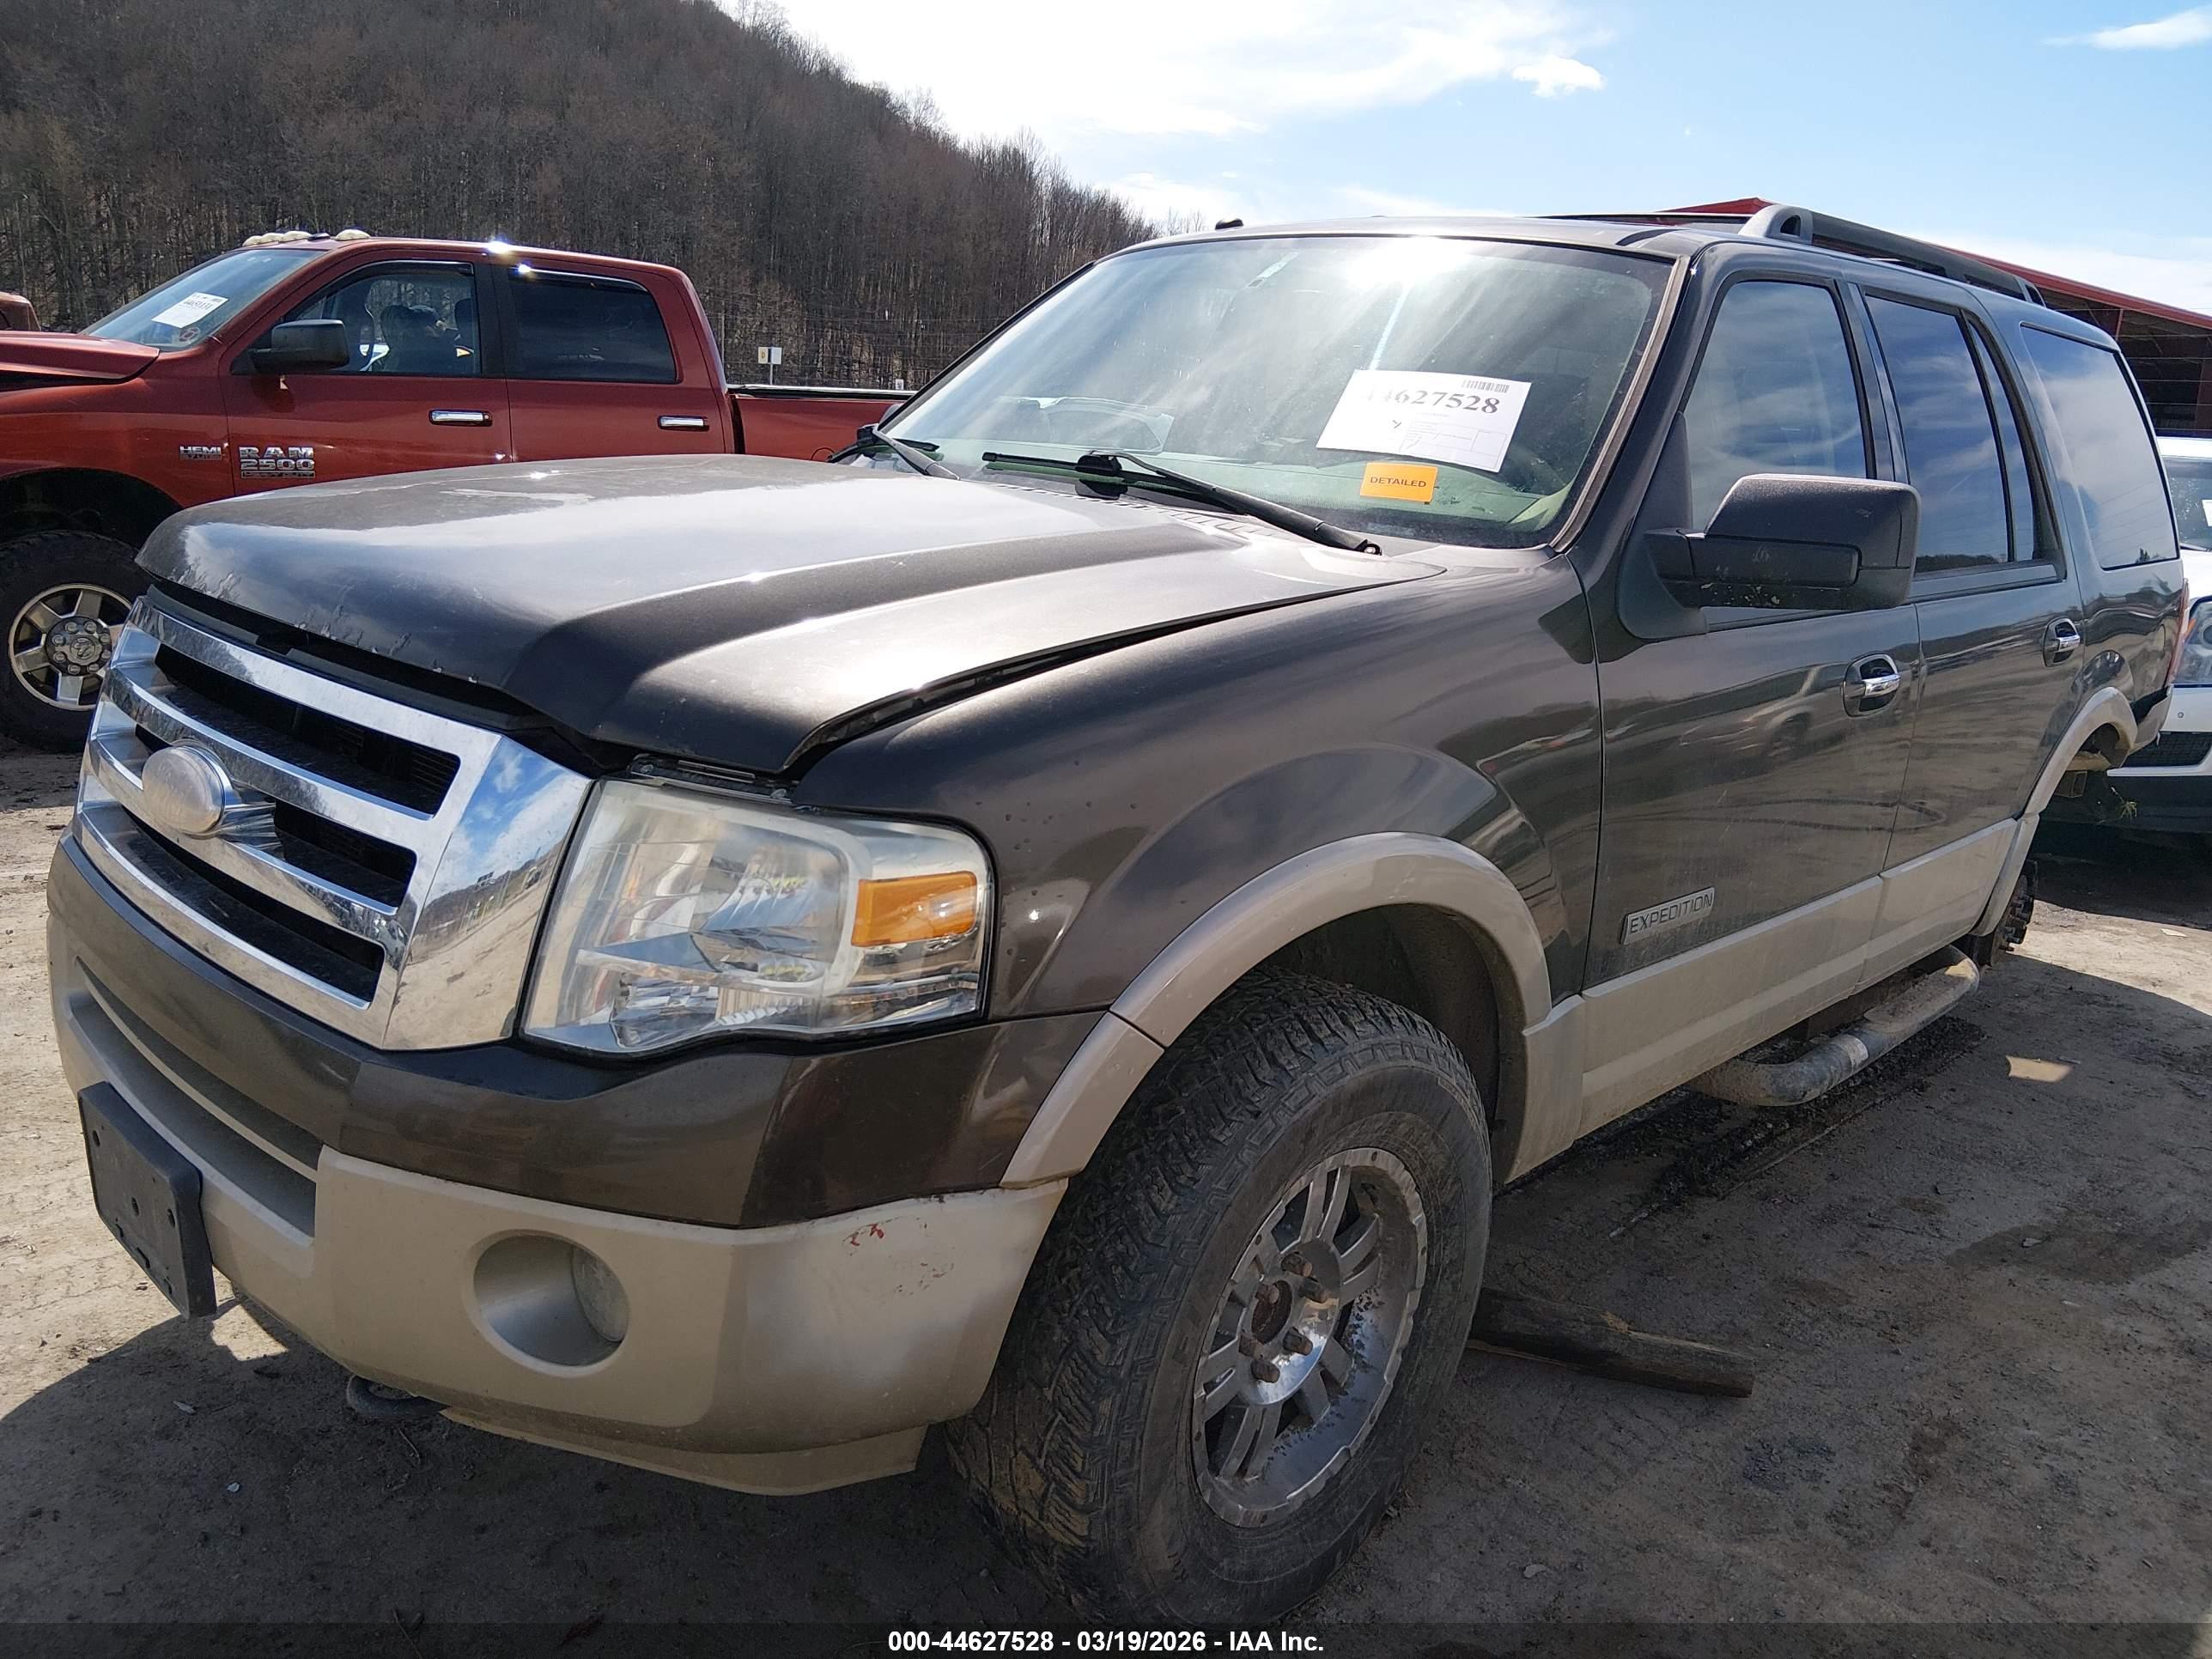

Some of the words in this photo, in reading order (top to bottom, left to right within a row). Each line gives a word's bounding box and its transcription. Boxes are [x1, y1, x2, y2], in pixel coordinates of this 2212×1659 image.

[179, 446, 222, 455] HEMI
[239, 447, 314, 459] RAM
[240, 459, 315, 471] 2500
[1370, 476, 1427, 489] DETAILED
[1629, 892, 1714, 933] EXPEDITION
